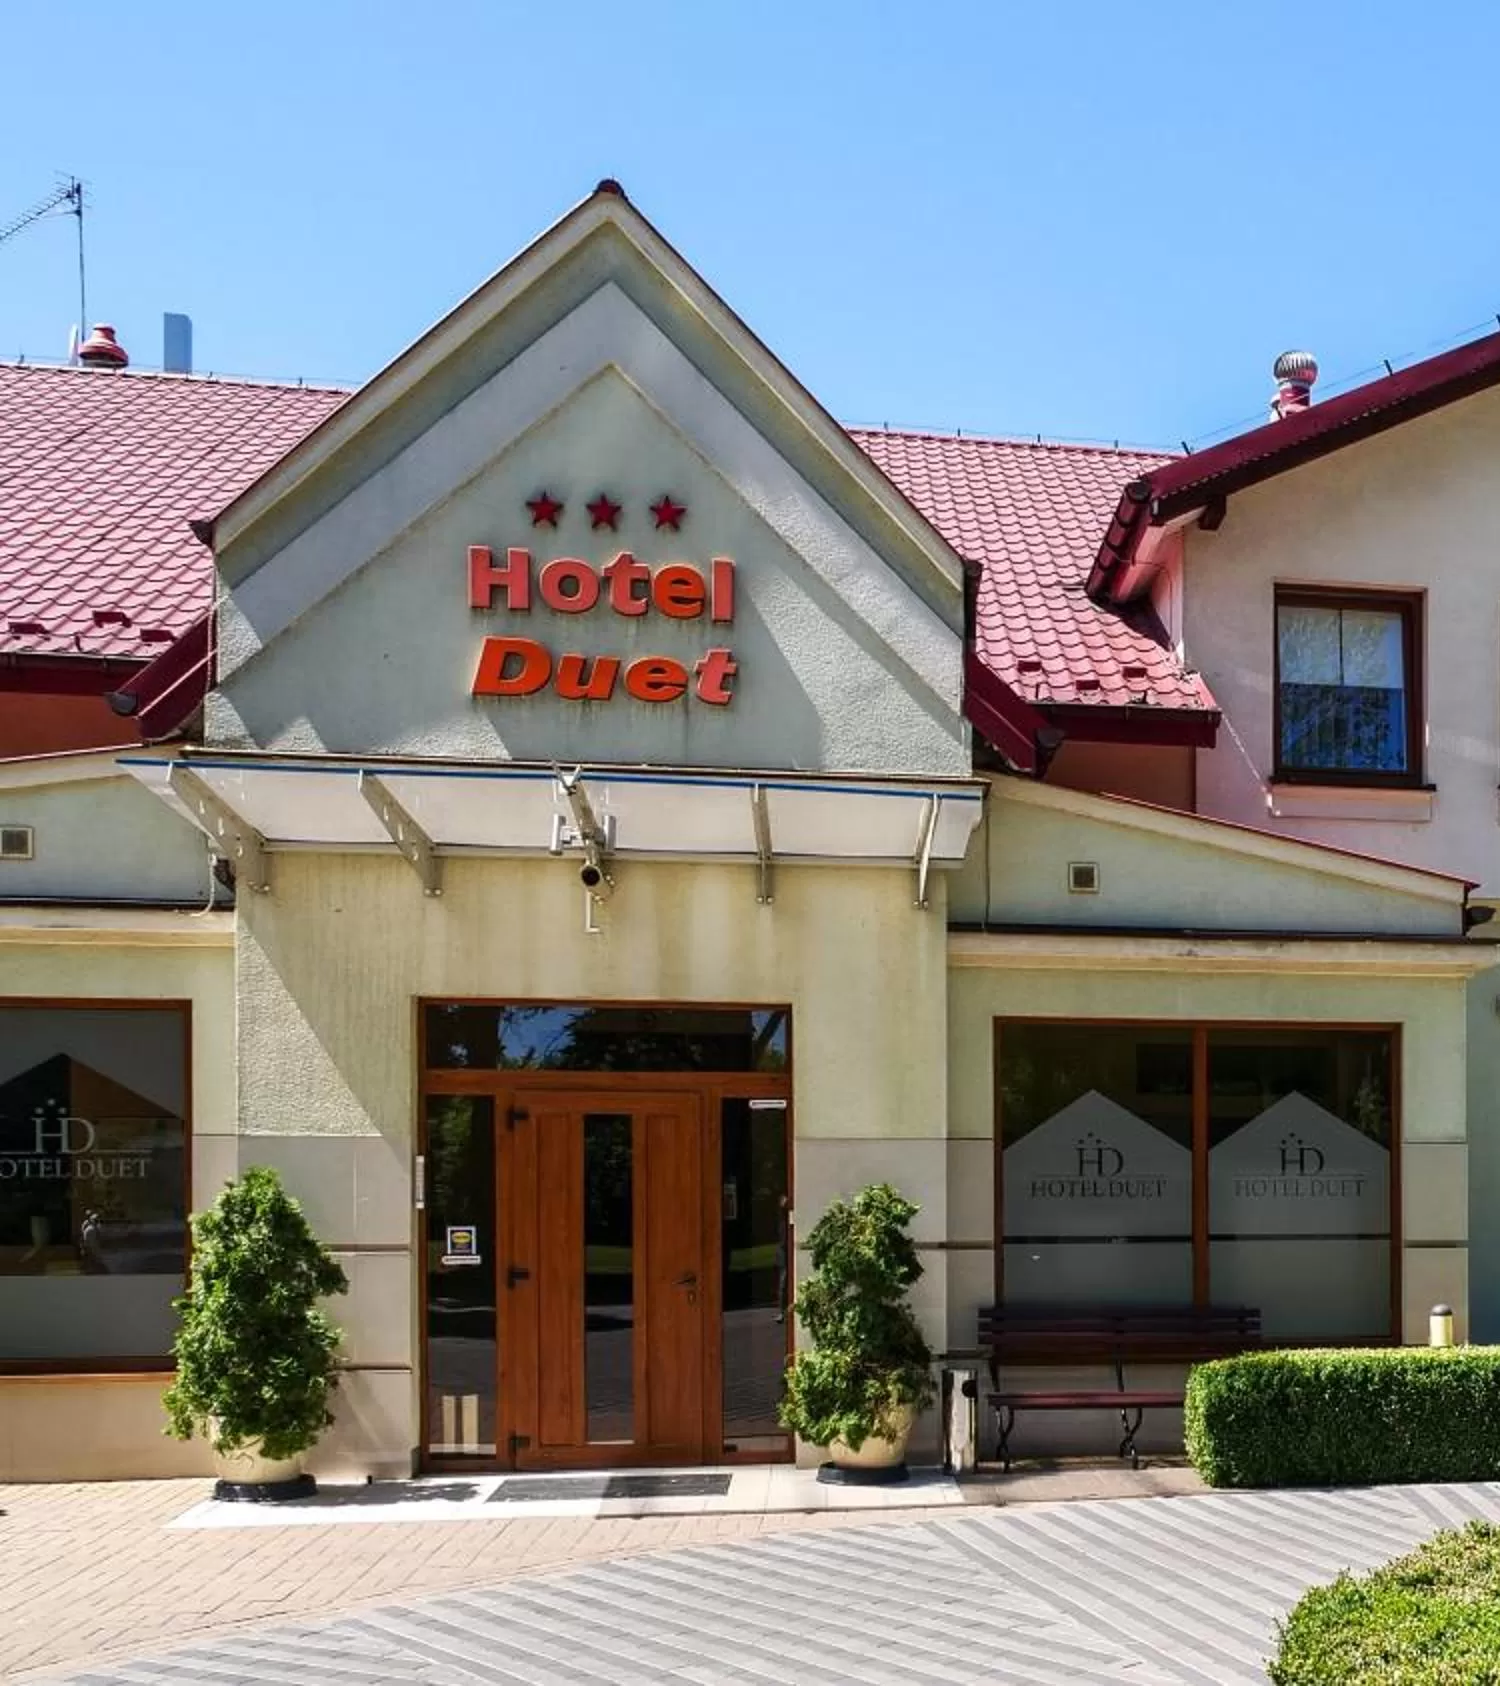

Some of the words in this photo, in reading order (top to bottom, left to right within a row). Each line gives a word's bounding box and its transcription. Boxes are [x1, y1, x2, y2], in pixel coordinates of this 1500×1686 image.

[467, 545, 737, 622] Hotel
[471, 635, 738, 705] Duet
[76, 1158, 152, 1178] DUET
[1031, 1180, 1105, 1198] HOTEL
[1109, 1180, 1167, 1198] DUET
[1234, 1179, 1306, 1197] HOTEL
[1311, 1179, 1365, 1197] DUET
